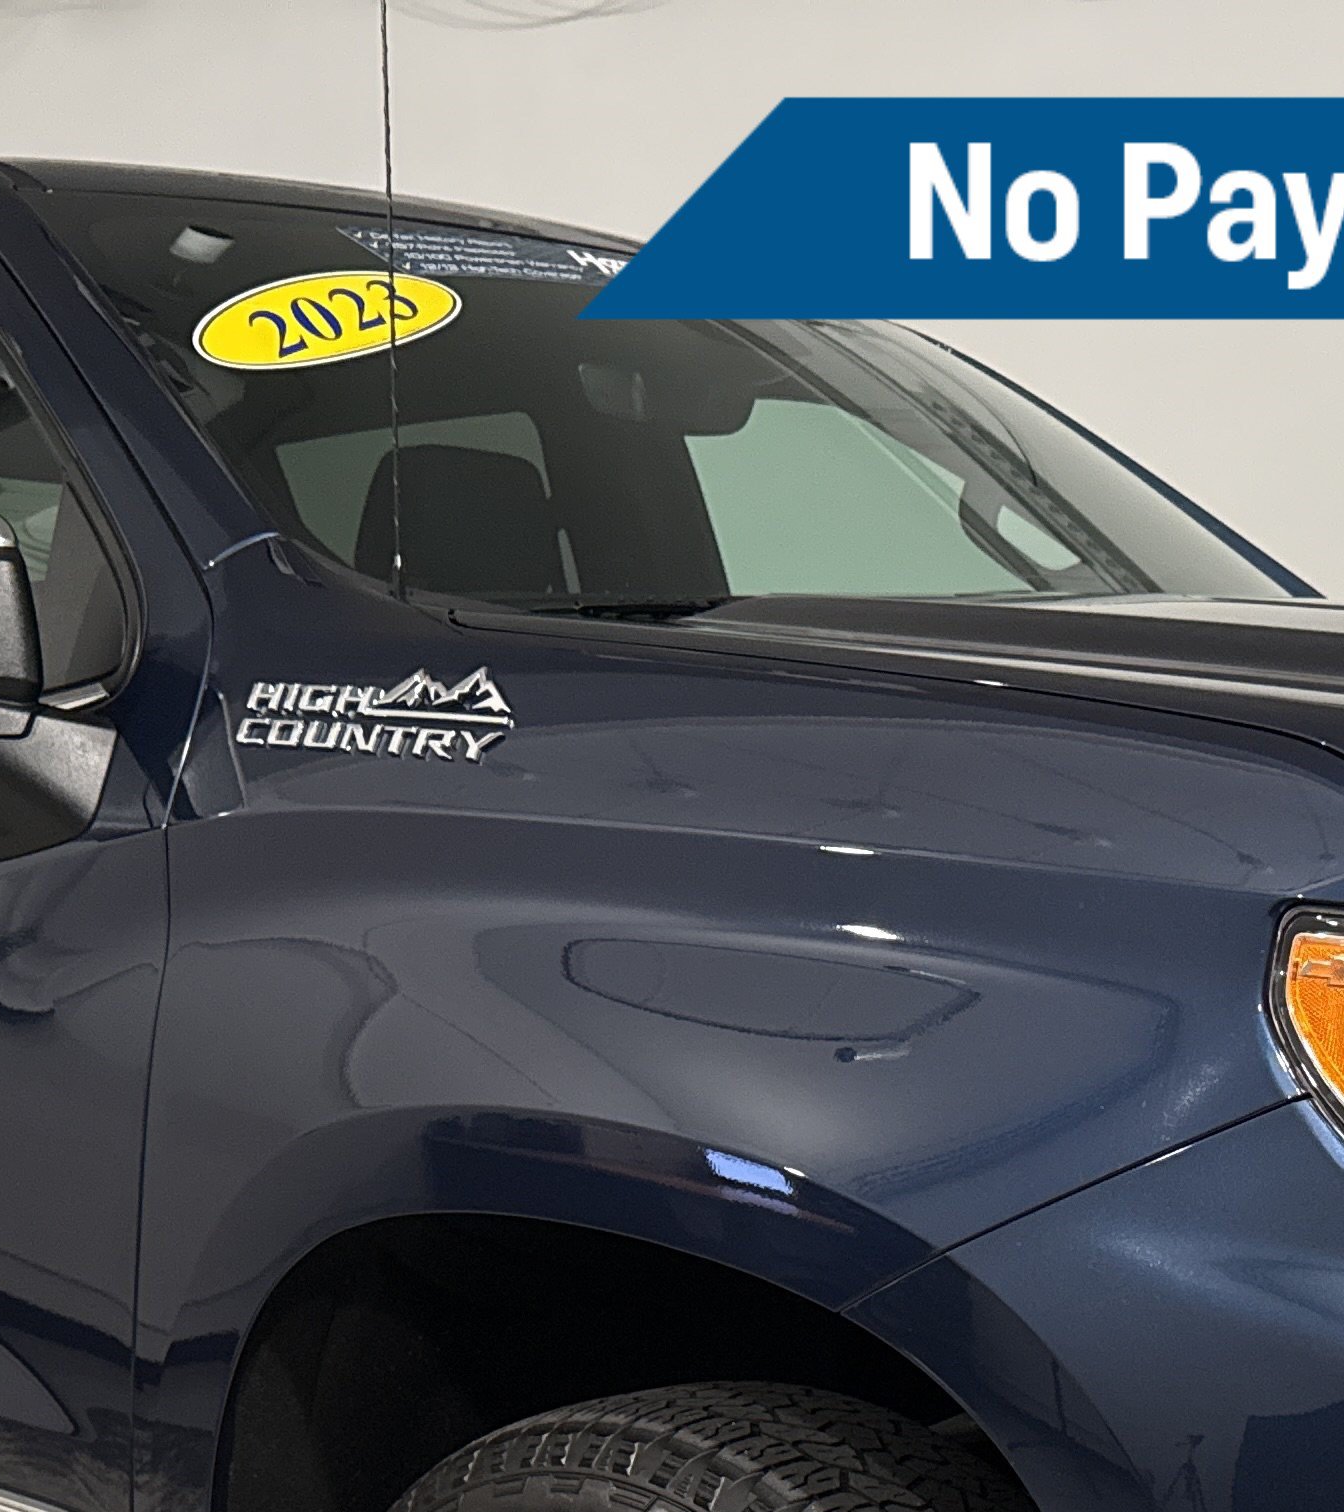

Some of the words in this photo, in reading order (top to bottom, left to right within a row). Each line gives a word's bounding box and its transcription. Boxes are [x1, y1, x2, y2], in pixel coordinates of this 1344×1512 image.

[248, 279, 419, 359] 2023
[246, 681, 384, 715] HIGH
[235, 716, 506, 766] COUNTRY
